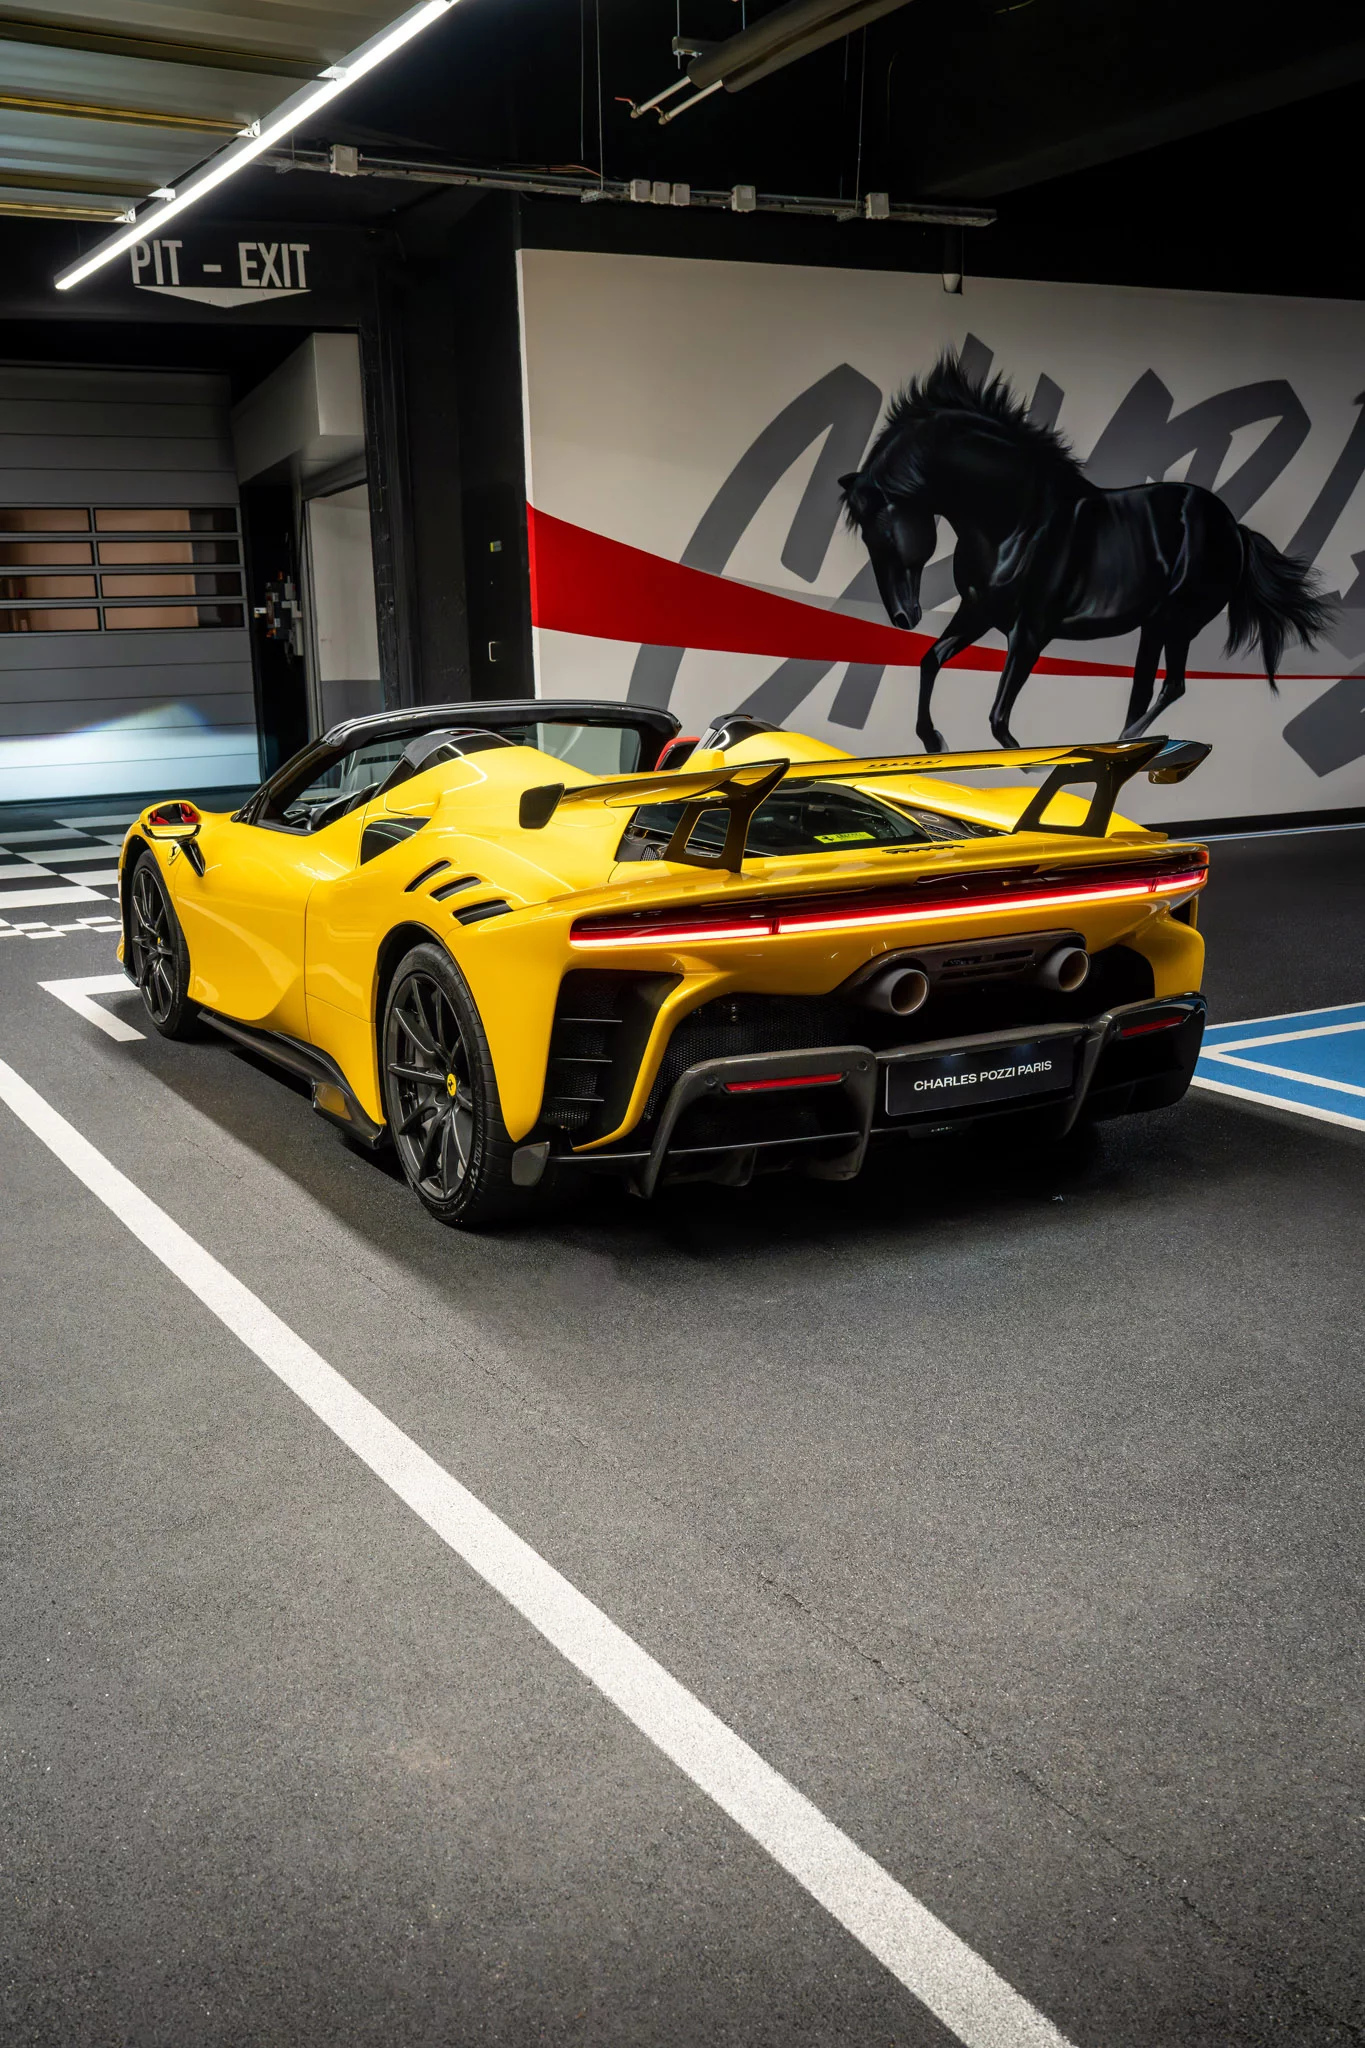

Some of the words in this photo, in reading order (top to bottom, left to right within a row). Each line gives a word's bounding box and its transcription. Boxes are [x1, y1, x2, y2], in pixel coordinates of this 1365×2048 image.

[129, 239, 183, 285] PIT
[238, 242, 310, 288] EXIT
[913, 1073, 977, 1091] CHARLES
[979, 1066, 1015, 1082] POZZI
[1017, 1060, 1053, 1076] PARIS
